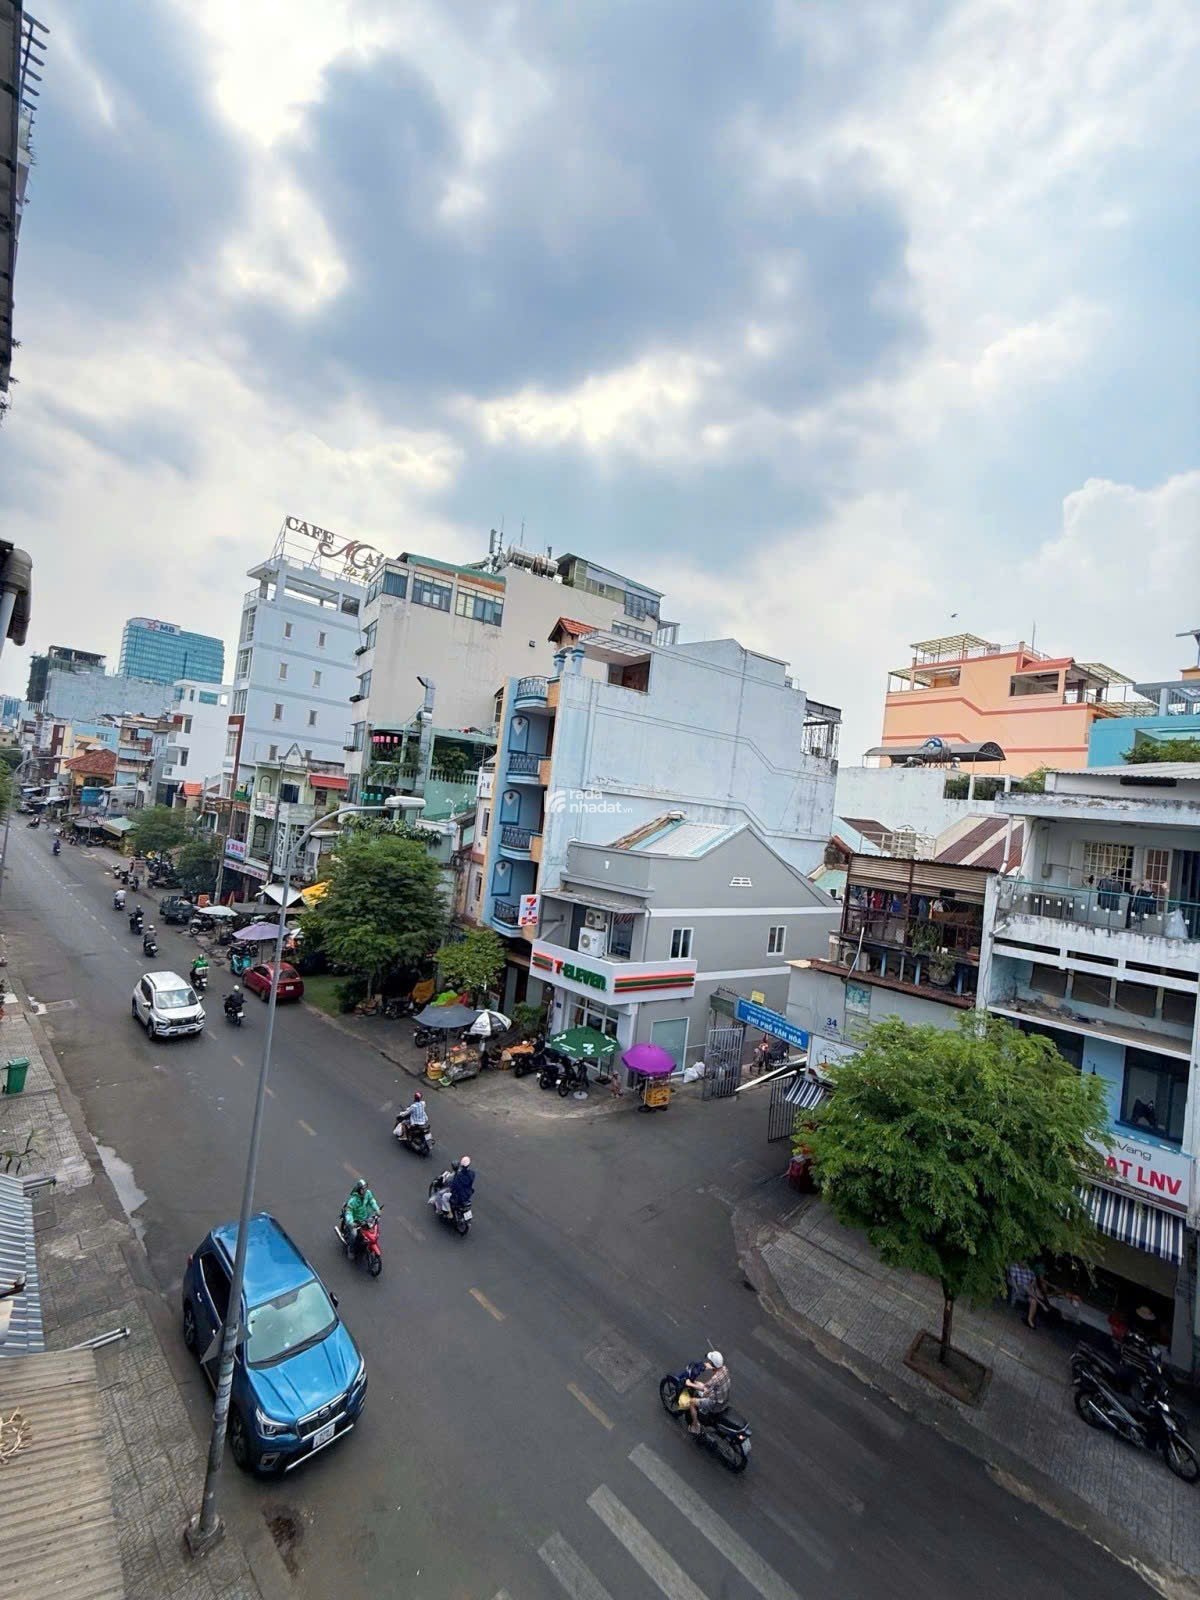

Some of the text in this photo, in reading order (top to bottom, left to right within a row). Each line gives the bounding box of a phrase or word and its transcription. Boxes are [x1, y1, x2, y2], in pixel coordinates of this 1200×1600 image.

[286, 516, 335, 545] CAFE
[160, 624, 175, 633] MB
[526, 897, 537, 907] 7
[746, 1014, 759, 1025] KHU
[826, 1018, 838, 1027] 34
[1137, 1166, 1182, 1196] LNV
